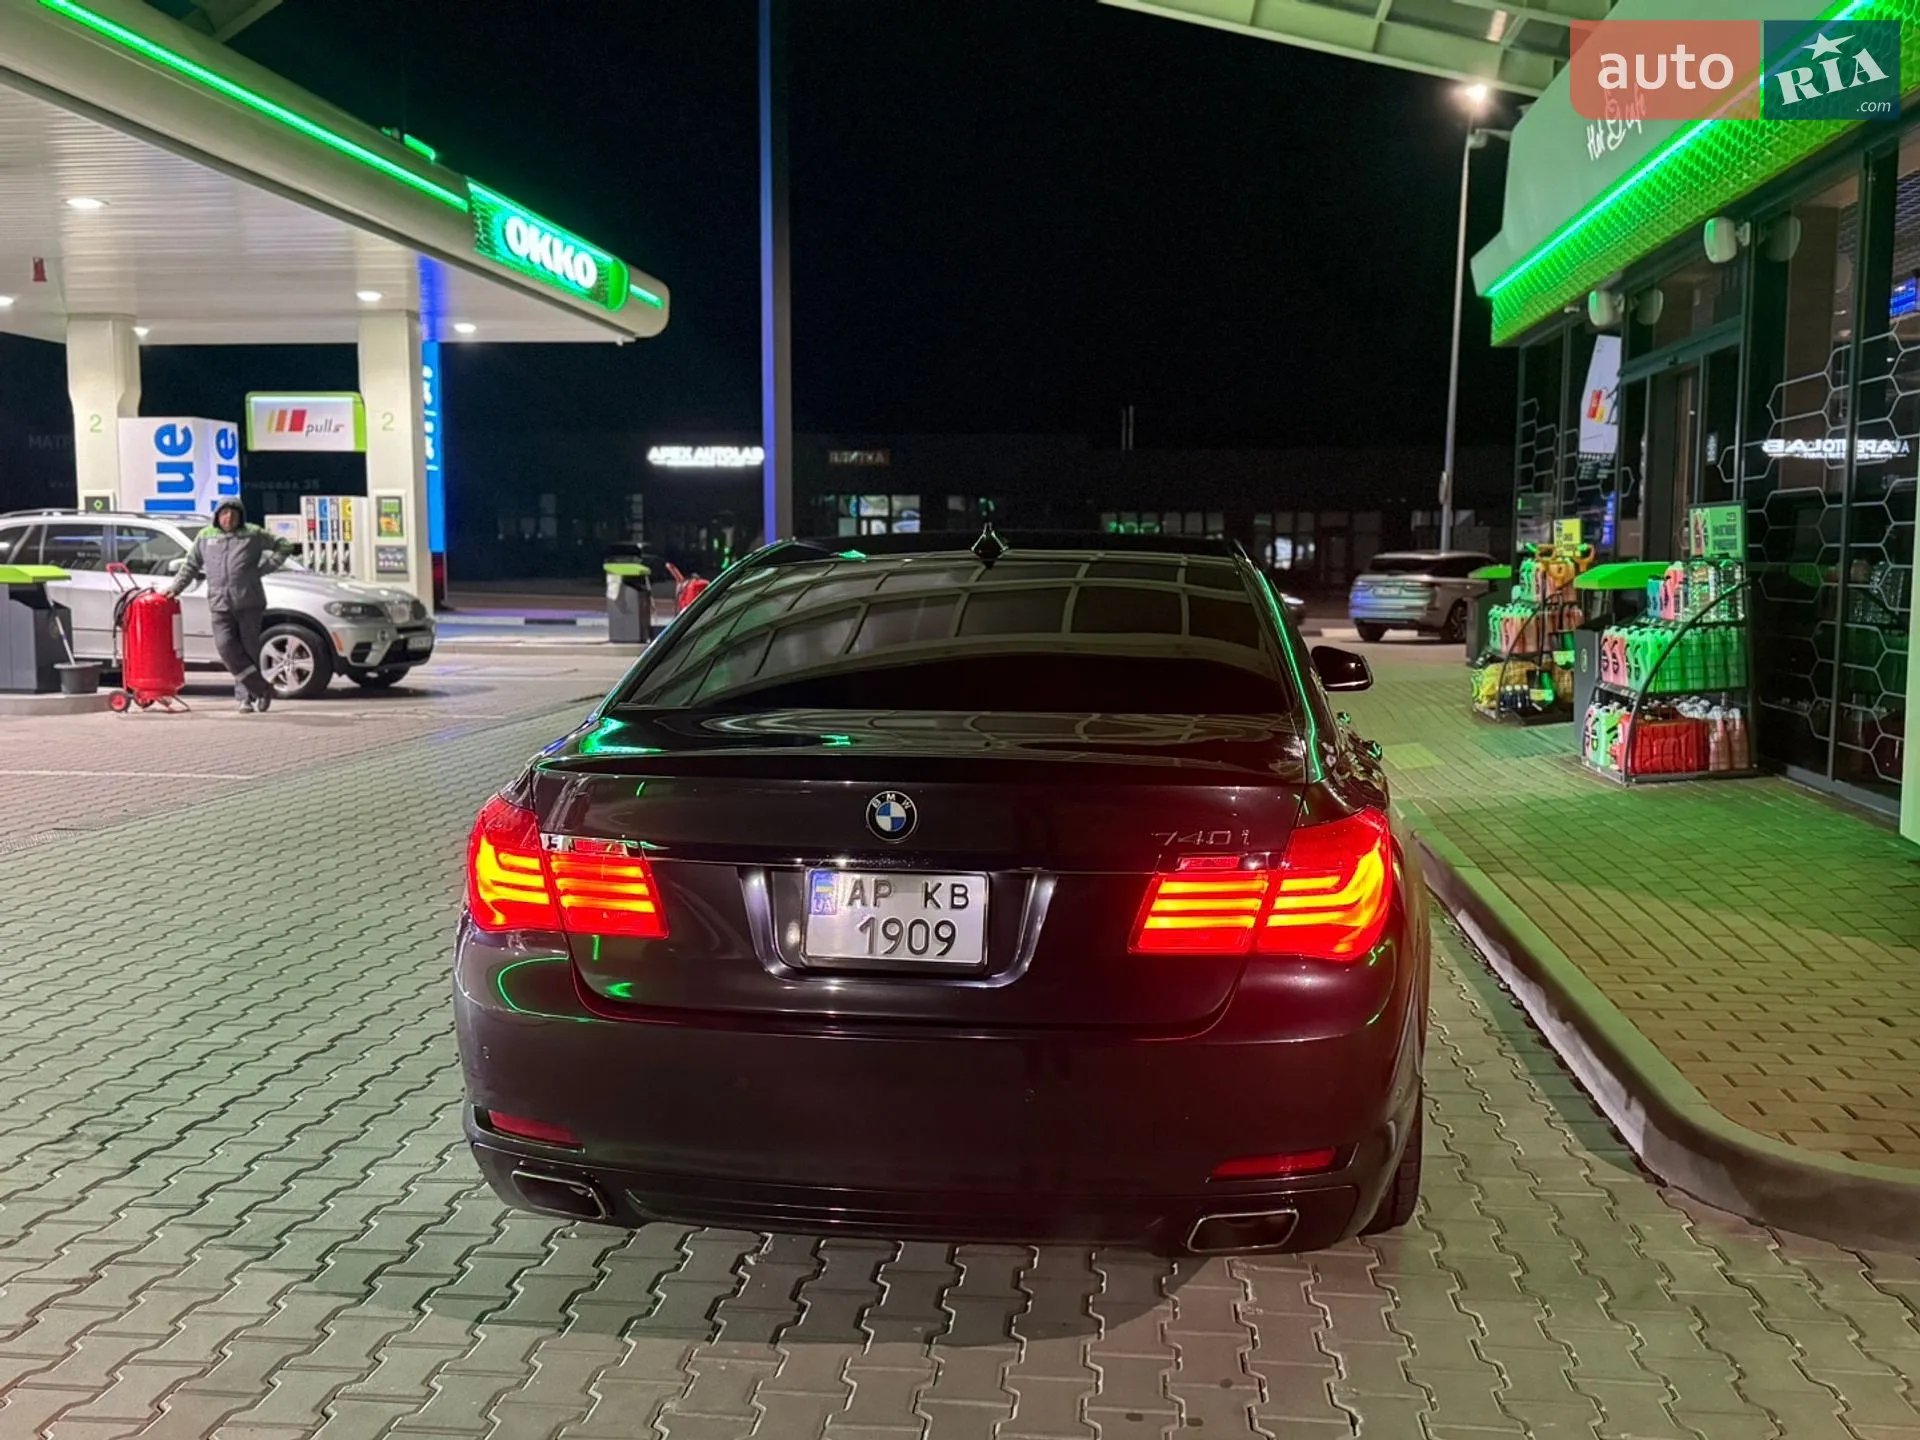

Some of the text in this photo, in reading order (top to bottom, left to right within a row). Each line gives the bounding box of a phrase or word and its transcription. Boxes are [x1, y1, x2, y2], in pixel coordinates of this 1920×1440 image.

[505, 215, 598, 289] OKKO
[90, 414, 102, 433] 2
[382, 411, 395, 431] 2
[812, 898, 835, 915] UA
[848, 878, 970, 910] AP KB
[857, 915, 958, 956] 1909
